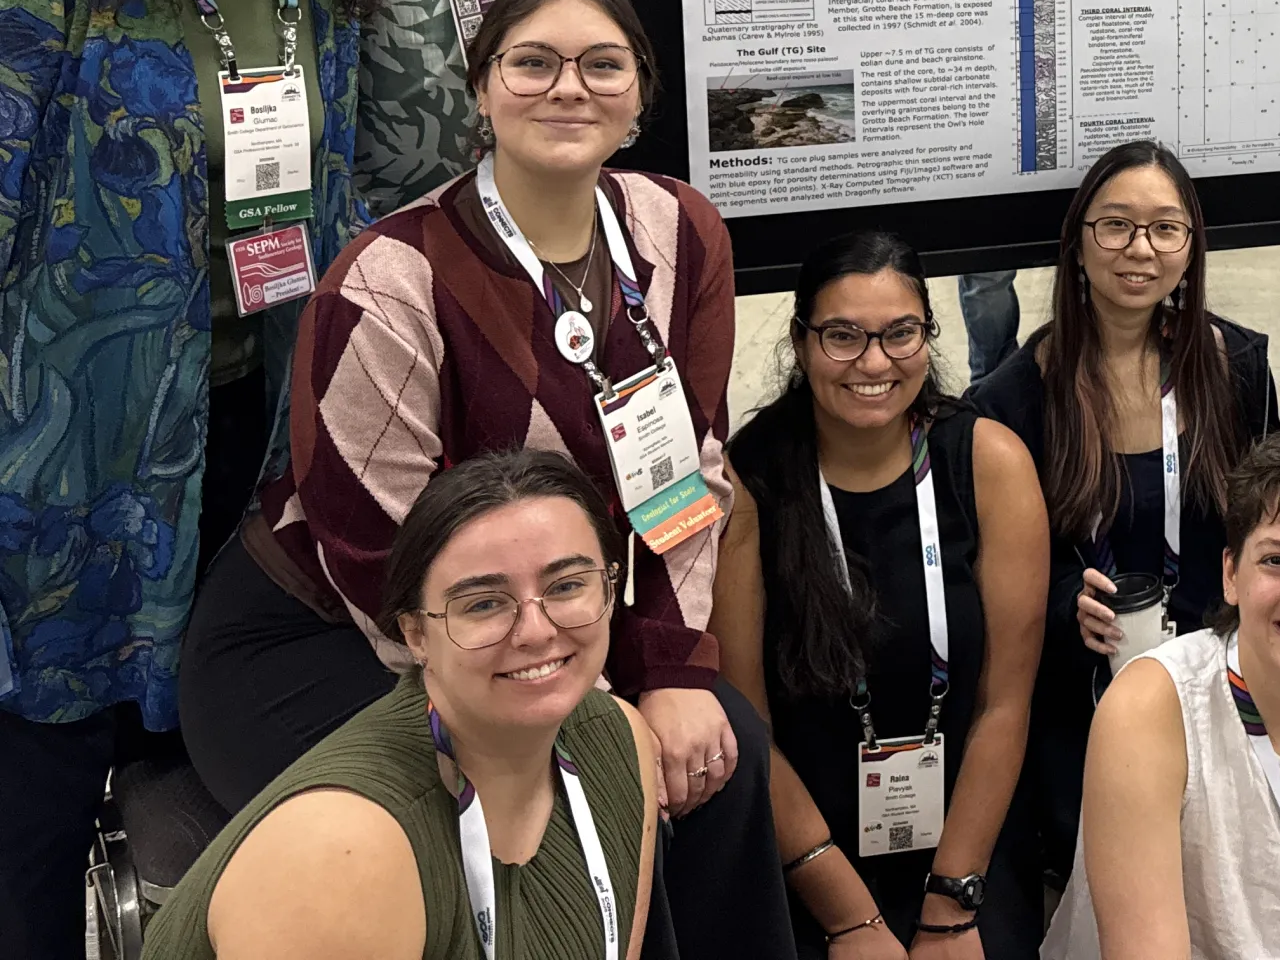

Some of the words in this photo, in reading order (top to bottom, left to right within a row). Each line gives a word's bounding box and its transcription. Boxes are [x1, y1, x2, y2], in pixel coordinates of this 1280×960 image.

[736, 48, 755, 56] The
[757, 47, 778, 55] Gulf
[781, 46, 803, 56] (TG)
[806, 45, 826, 53] Site
[251, 104, 277, 114] Bosiljka
[253, 117, 278, 125] Glumac
[709, 155, 772, 168] Methods:
[239, 208, 262, 218] GSA
[264, 203, 297, 215] Fellow
[246, 236, 280, 256] SEPM
[637, 406, 656, 422] Isabel
[637, 415, 664, 434] Espinosa
[649, 525, 681, 549] Student
[680, 505, 717, 529] Volunteer
[890, 775, 910, 783] Raina
